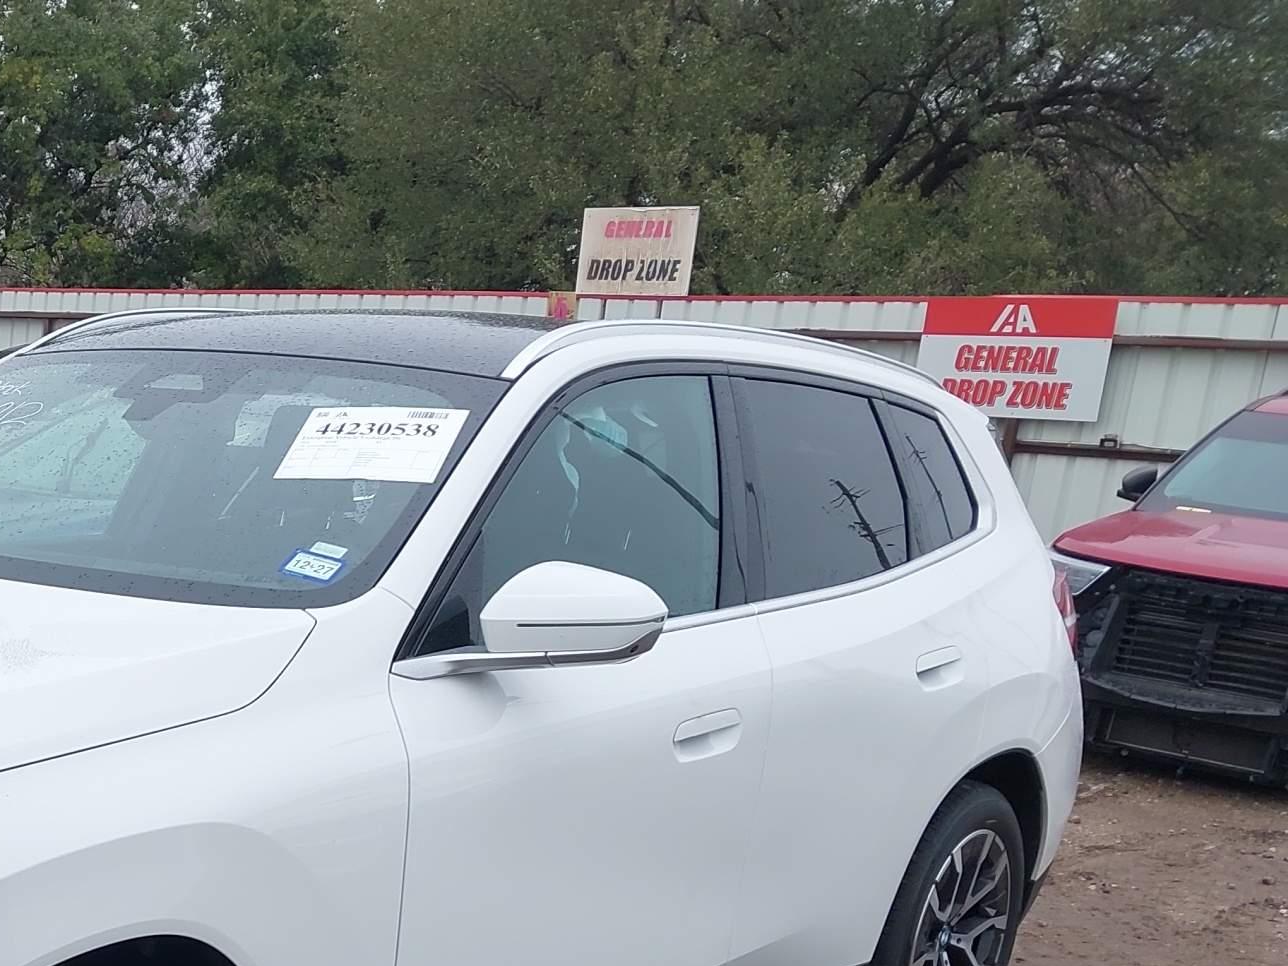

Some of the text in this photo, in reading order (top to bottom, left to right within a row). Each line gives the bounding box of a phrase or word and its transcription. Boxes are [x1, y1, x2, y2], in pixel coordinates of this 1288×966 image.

[603, 219, 674, 238] GENERAL
[585, 258, 681, 282] DROP ZONE
[954, 344, 1060, 375] GENERAL
[1005, 380, 1073, 411] ZONE
[315, 422, 440, 438] 44230538
